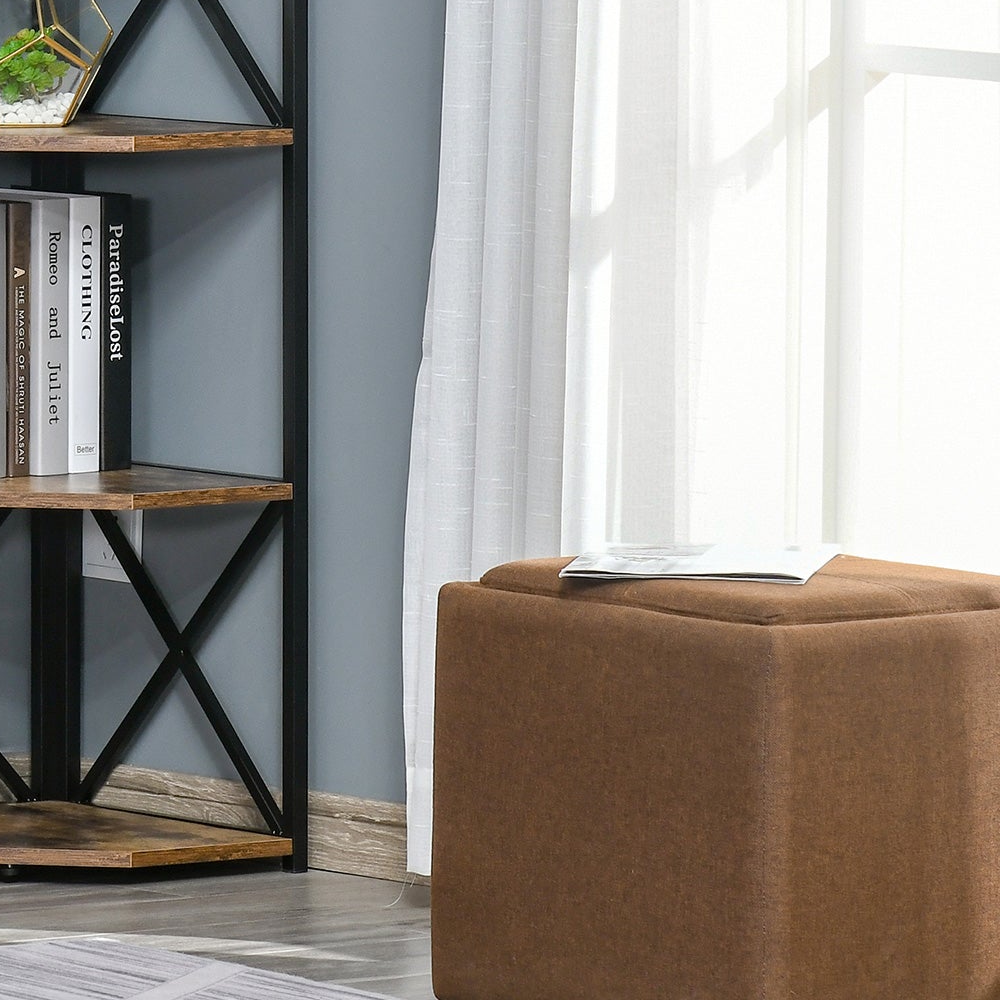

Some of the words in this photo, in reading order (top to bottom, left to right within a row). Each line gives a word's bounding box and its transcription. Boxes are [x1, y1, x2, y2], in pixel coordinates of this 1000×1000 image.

[49, 231, 61, 285] Romeo
[81, 225, 93, 340] CLOTHING
[49, 307, 62, 339] and
[19, 355, 25, 370] OF
[47, 361, 61, 425] Juliet
[76, 445, 95, 453] Better
